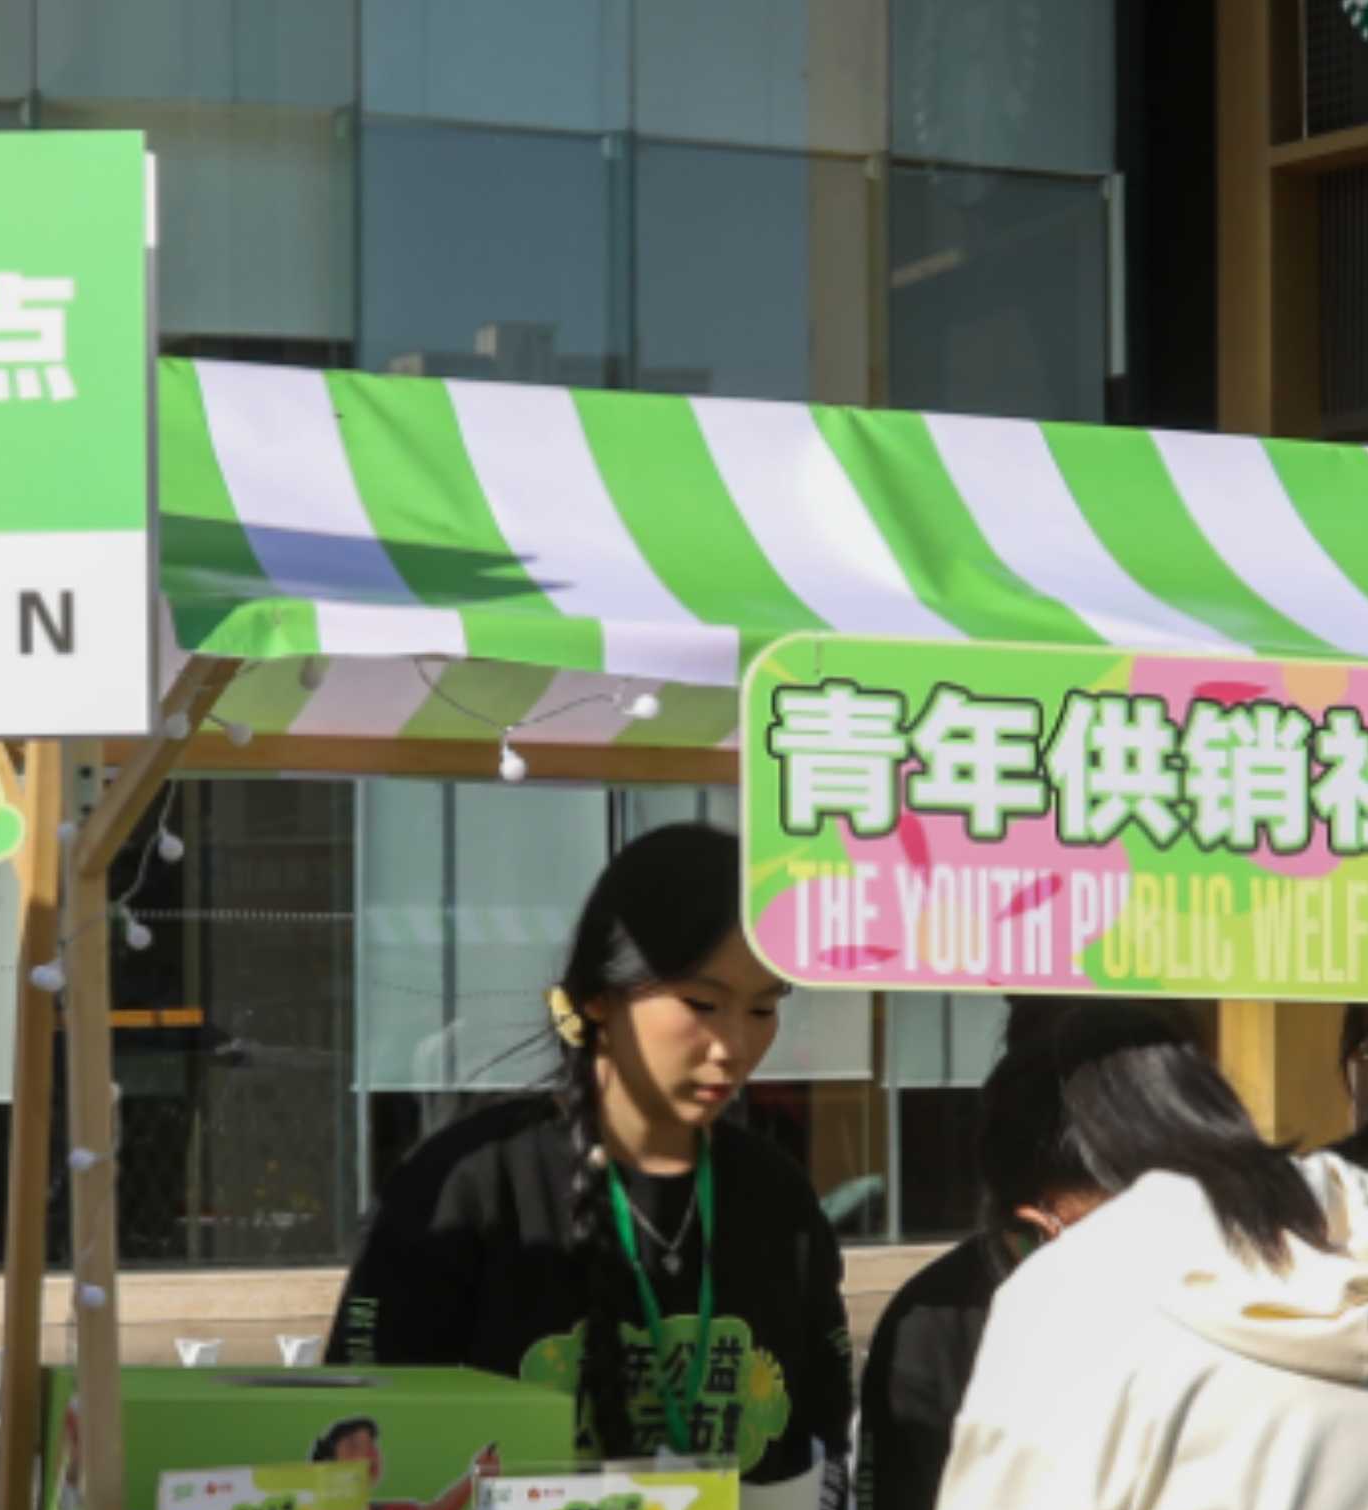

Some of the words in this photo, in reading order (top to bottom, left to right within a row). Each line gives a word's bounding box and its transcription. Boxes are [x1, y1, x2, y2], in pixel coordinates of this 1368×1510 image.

[19, 590, 74, 655] N
[787, 861, 882, 972] THE
[896, 865, 1053, 976] YOUTH
[1071, 868, 1233, 980] PUBLIC
